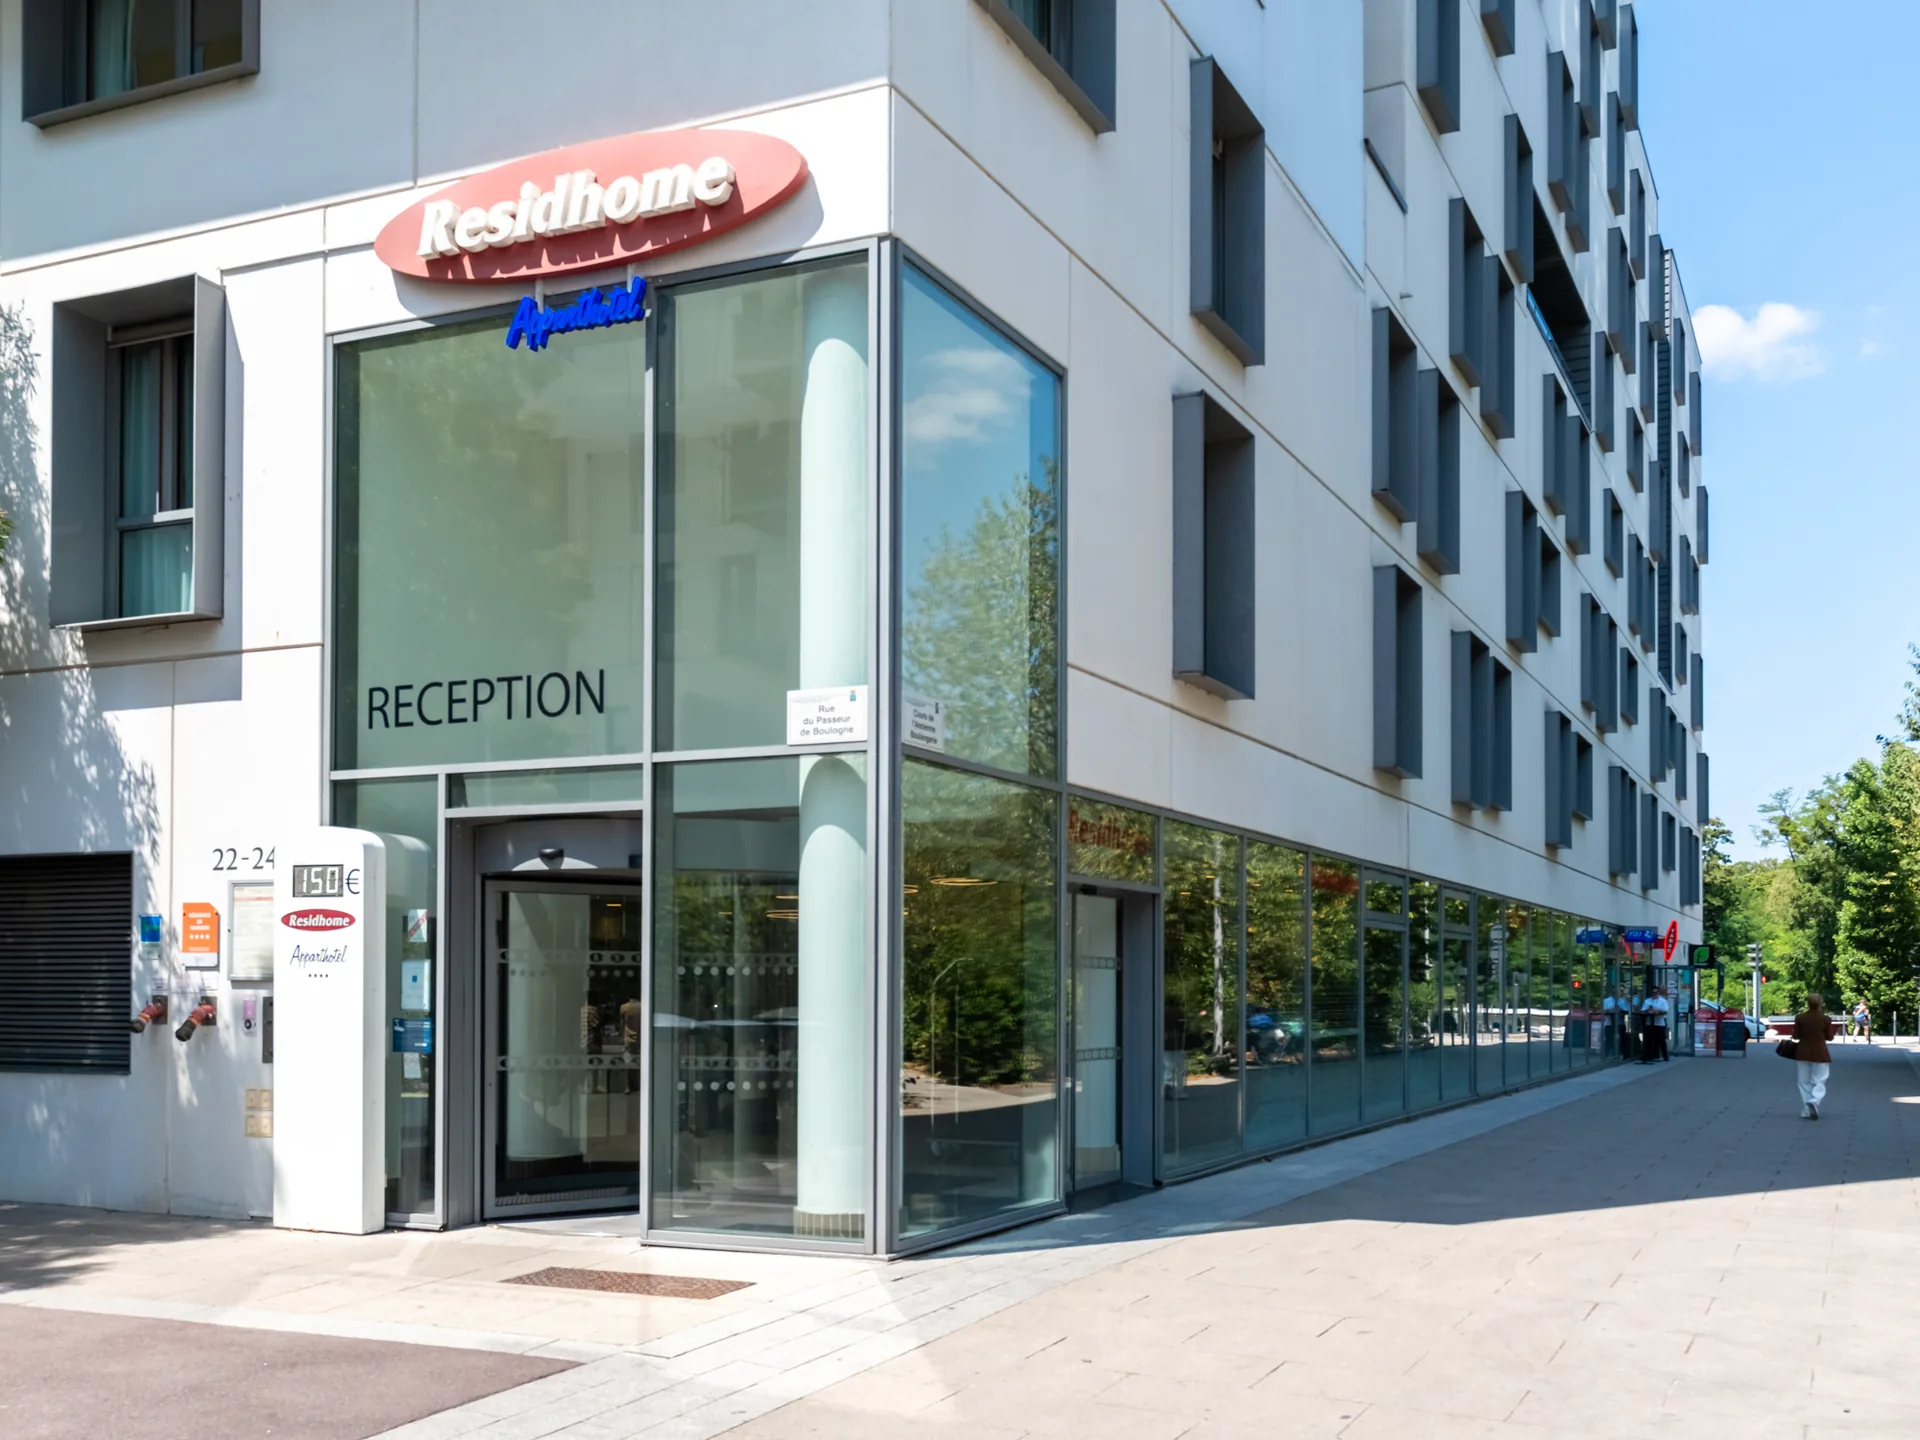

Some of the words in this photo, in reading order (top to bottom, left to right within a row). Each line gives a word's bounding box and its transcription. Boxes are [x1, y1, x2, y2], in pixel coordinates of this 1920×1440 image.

[416, 156, 736, 260] Residhome
[368, 669, 605, 730] RECEPTION
[818, 705, 835, 713] Rue
[813, 726, 854, 736] Boulogne
[816, 715, 851, 725] Passeur
[212, 846, 276, 871] 22-24
[302, 867, 339, 894] 150
[345, 868, 360, 895] €
[289, 914, 350, 927] Residhome
[1666, 928, 1676, 954] TABAC
